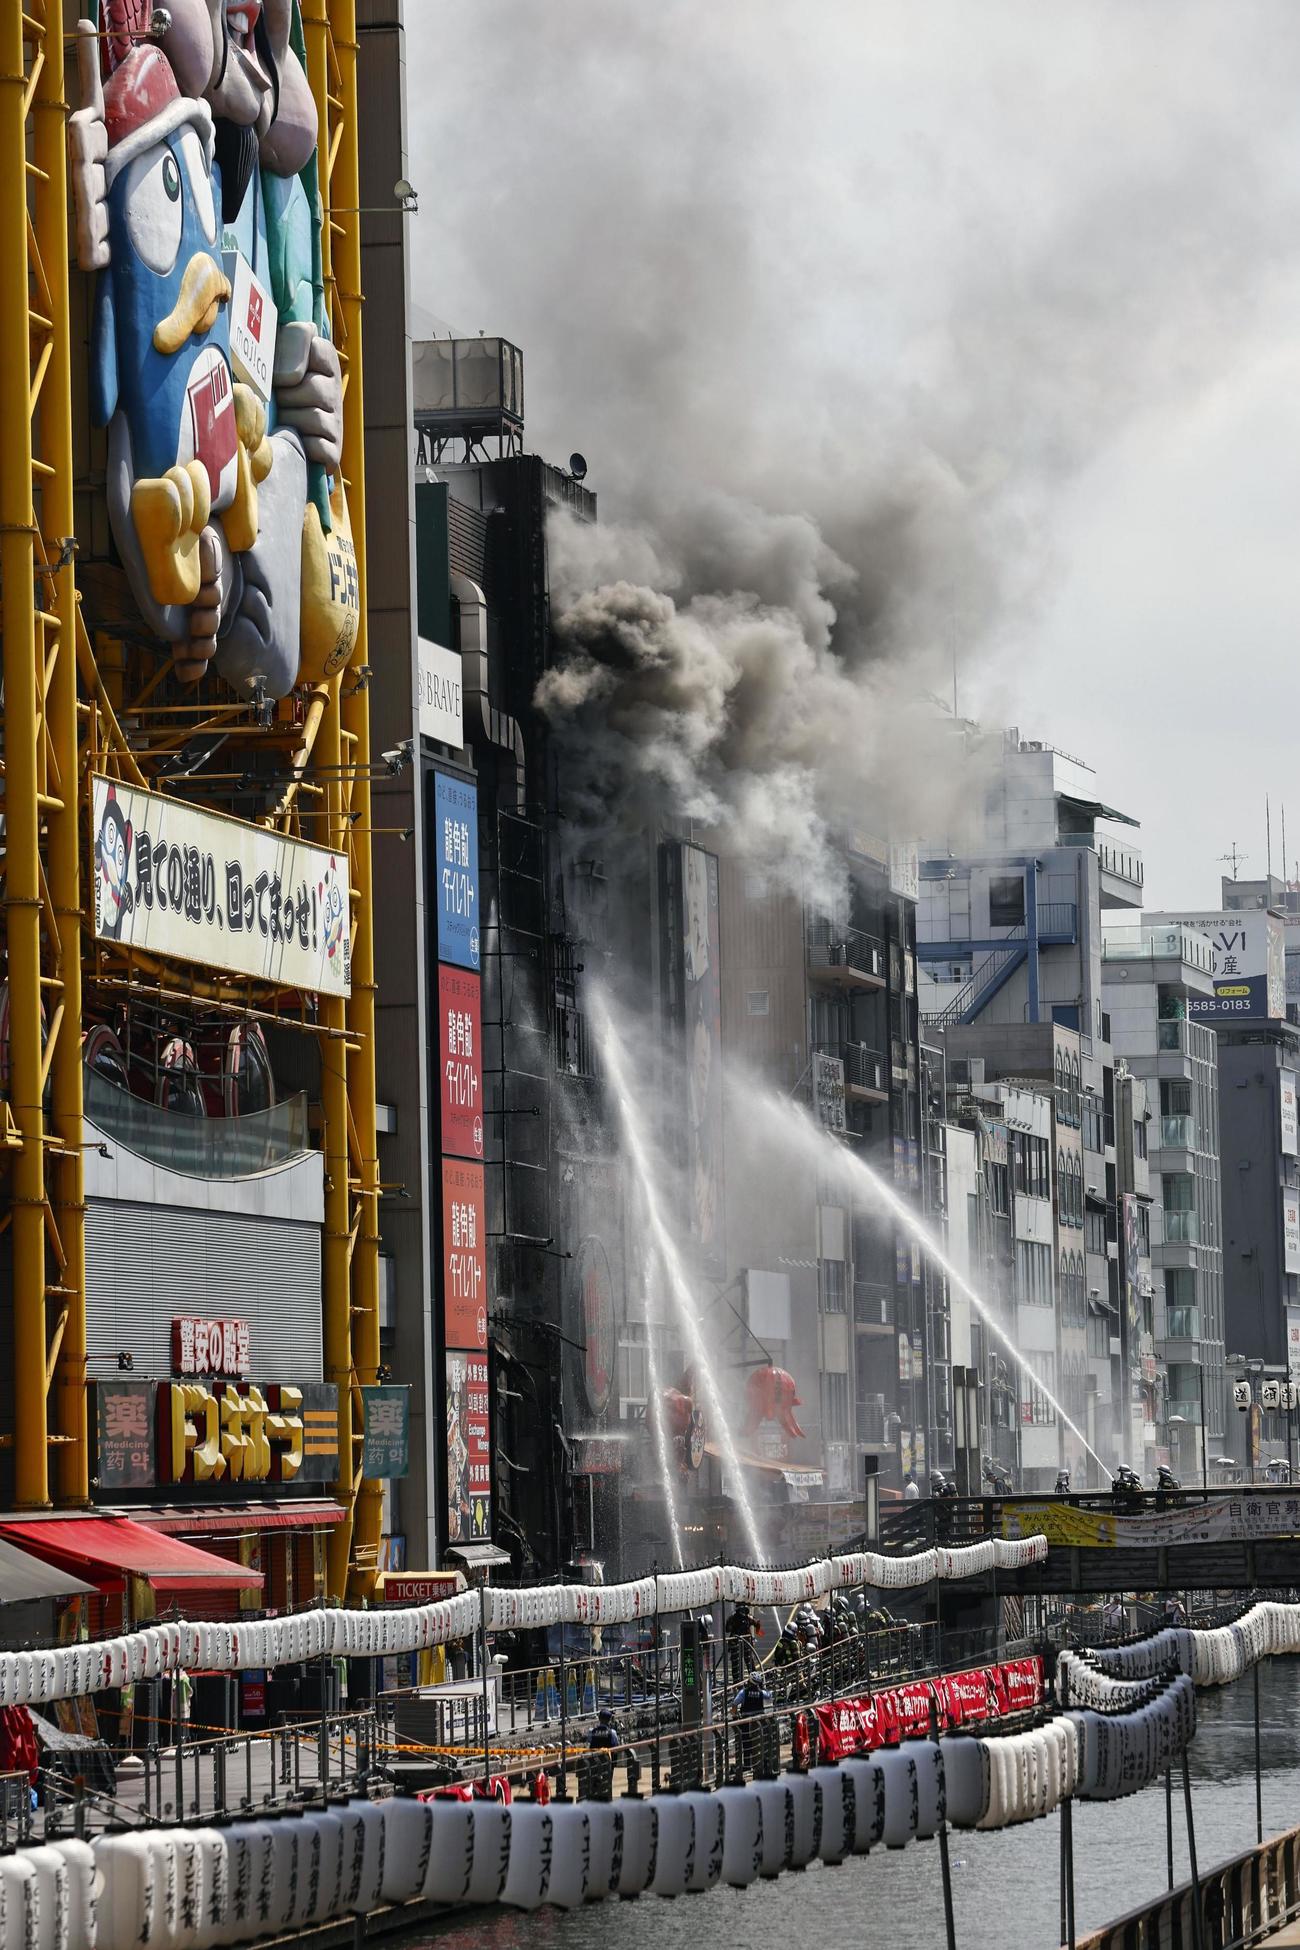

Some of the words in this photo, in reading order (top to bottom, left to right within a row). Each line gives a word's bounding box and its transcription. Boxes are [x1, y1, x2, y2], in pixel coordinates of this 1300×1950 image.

[426, 670, 461, 718] BRAVE
[444, 816, 470, 868] 龍角散
[447, 1008, 473, 1058] 龍角散
[451, 1200, 477, 1249] 龍角散
[179, 1318, 250, 1374] 驚安の殿堂
[104, 1393, 149, 1438] 薬
[369, 1398, 404, 1435] 薬
[104, 1440, 150, 1450] Medicine
[105, 1451, 125, 1471] 药
[396, 1582, 431, 1597] TICKET
